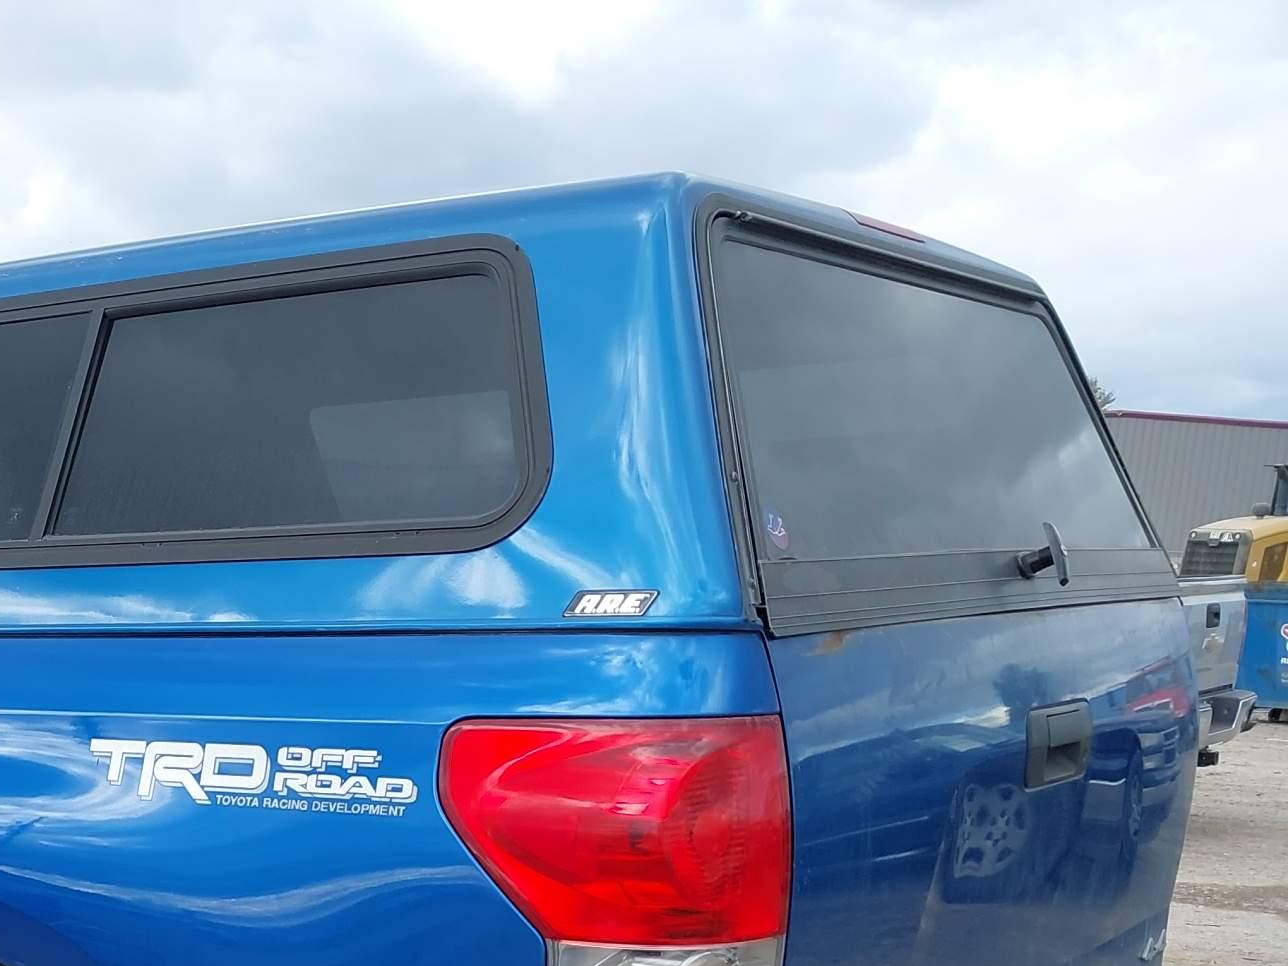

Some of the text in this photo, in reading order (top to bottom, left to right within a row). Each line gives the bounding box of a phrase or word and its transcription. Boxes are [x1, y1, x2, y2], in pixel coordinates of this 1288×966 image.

[90, 738, 382, 805] TRD OFF
[273, 771, 418, 804] ROAD
[215, 795, 407, 817] TOYOTA RACING DEVELOPMENT
